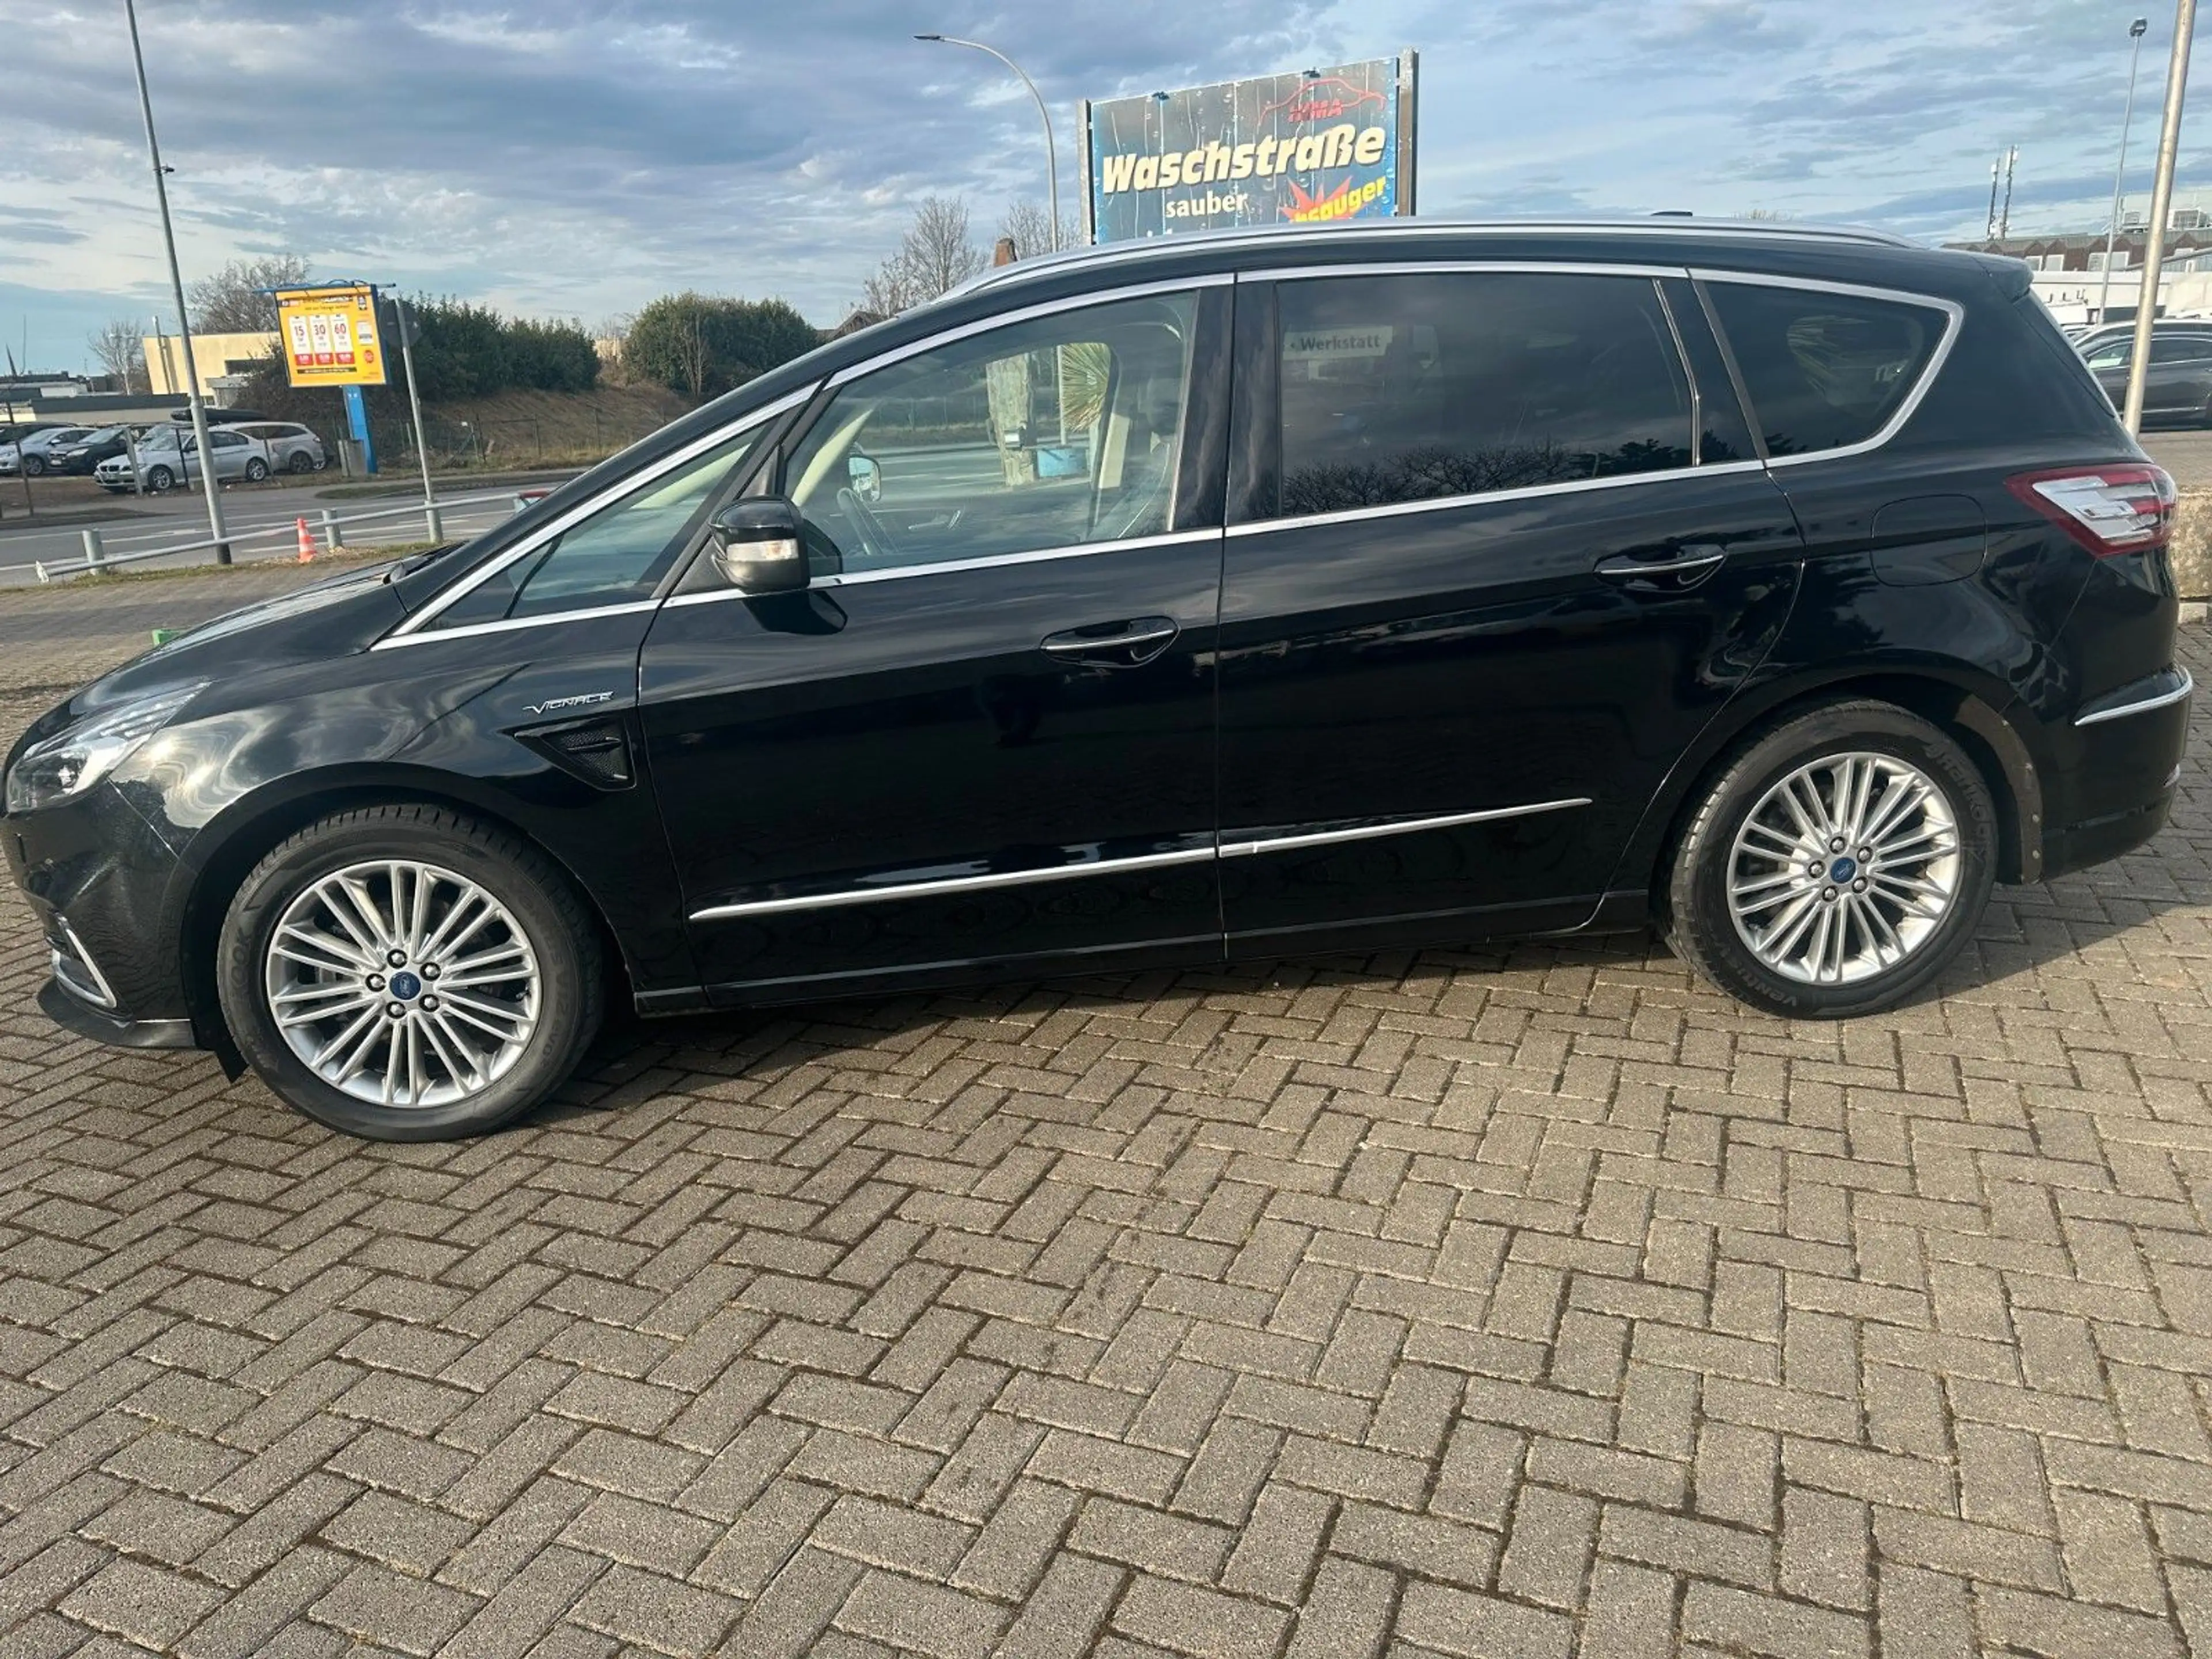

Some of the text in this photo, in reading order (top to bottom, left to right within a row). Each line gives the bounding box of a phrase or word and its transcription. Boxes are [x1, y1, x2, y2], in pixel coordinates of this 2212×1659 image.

[1103, 123, 1385, 194] Waschstraße
[1165, 191, 1248, 218] sauber
[294, 324, 305, 336] 15
[313, 324, 326, 335] 30
[334, 323, 346, 334] 60
[1300, 334, 1381, 351] Werkstatt
